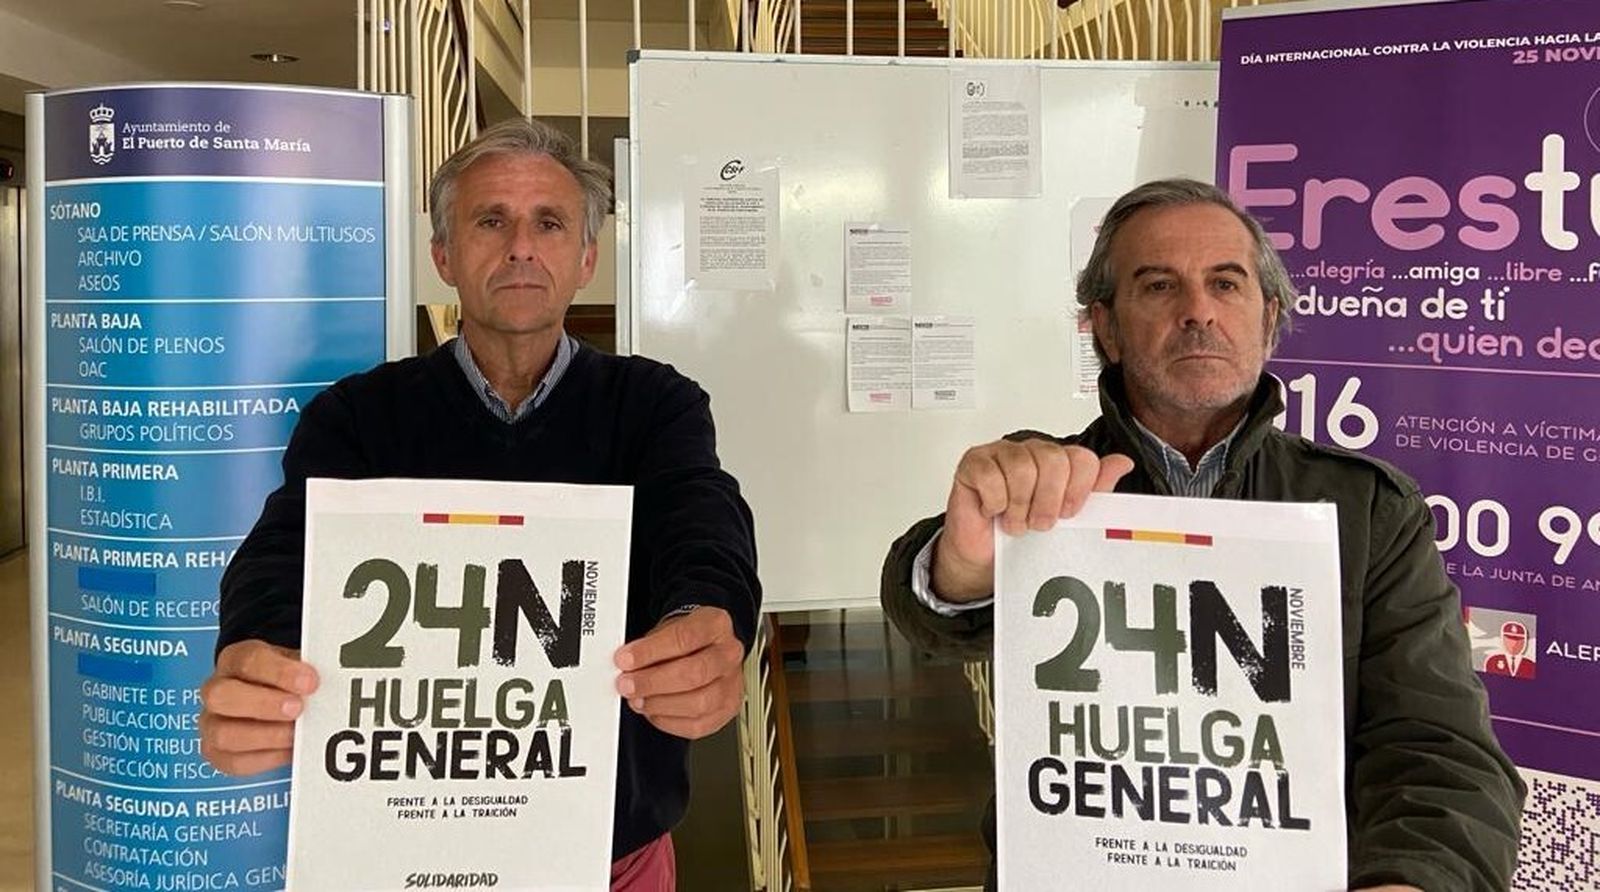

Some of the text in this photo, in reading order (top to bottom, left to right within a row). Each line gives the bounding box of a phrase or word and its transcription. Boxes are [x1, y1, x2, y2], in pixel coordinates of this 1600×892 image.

[1241, 53, 1263, 65] DÍA
[1266, 47, 1370, 63] INTERNACIONAL
[1373, 42, 1429, 56] CONTRA
[1433, 40, 1451, 51] LA
[1454, 36, 1530, 50] VIOLENCIA
[1534, 33, 1580, 45] HACIA
[1513, 50, 1538, 64] 25
[122, 121, 230, 135] Ayuntamiento de
[122, 137, 311, 152] El Puerto de Santa María
[50, 200, 101, 219] SÓTANO
[77, 222, 376, 243] SALA DE PRENSA / SALÓN MULTIUSOS
[78, 250, 142, 267] ARCHIVO
[78, 275, 120, 291] ASEOS
[1294, 285, 1408, 318] dueña
[1420, 287, 1468, 320] de
[51, 313, 142, 330] PLANTA BAJA
[79, 335, 225, 354] SALÓN DE PLENOS
[79, 361, 107, 378] OAC
[52, 397, 300, 417] PLANTA BAJA REHABILITADA
[80, 422, 234, 442] GRUPOS POLÍTICOS
[1396, 415, 1600, 442] ATENCIÓN A VÍCTIM
[1396, 434, 1600, 462] DE VIOLENCIA DE G
[52, 458, 179, 481] PLANTA PRIMERA
[80, 485, 106, 502] I.B.I.
[80, 508, 173, 530] ESTADÍSTICA
[1538, 506, 1600, 565] 9
[53, 542, 99, 565] PLANTA
[103, 550, 179, 568] PRIMERA
[1463, 564, 1484, 578] LA
[1489, 568, 1545, 585] JUNTA
[1552, 575, 1576, 589] DE
[81, 594, 124, 615] SALÓN
[129, 601, 150, 617] DE
[582, 560, 599, 637] NOVIEMBRE
[339, 558, 586, 669] 24N
[54, 626, 188, 656] PLANTA SEGUNDA
[1032, 575, 1292, 703] 24N
[1289, 587, 1306, 671] NOVIEMBRE
[82, 681, 147, 704] GABINETE
[154, 688, 176, 706] DE
[349, 677, 570, 729] HUELGA
[82, 704, 200, 730] PUBLICACIONES
[83, 729, 140, 753] GESTIÓN
[1048, 701, 1286, 770] HUELGA
[83, 752, 168, 779] INSPECCIÓN
[324, 726, 587, 782] GENERAL
[56, 780, 291, 818] PLANTA SEGUNDA REHABILI
[387, 795, 528, 806] FRENTE A LA DESIGUALDAD
[1027, 757, 1312, 830] GENERAL
[398, 806, 517, 818] FRENTE A LA TRAICIÓN
[83, 813, 262, 842] SECRETARÍA GENERAL
[84, 836, 208, 867] CONTRATACIÓN
[1096, 837, 1136, 850] FRENTE
[1156, 842, 1167, 851] LA
[1175, 844, 1248, 857] DESIGUALDAD
[1108, 853, 1148, 865] FRENTE
[1155, 857, 1161, 865] A
[1168, 858, 1180, 867] LA
[84, 861, 150, 890] ASESORÍA
[156, 870, 239, 889] JURÍDICA
[405, 872, 498, 888] SOLIDARIDAD
